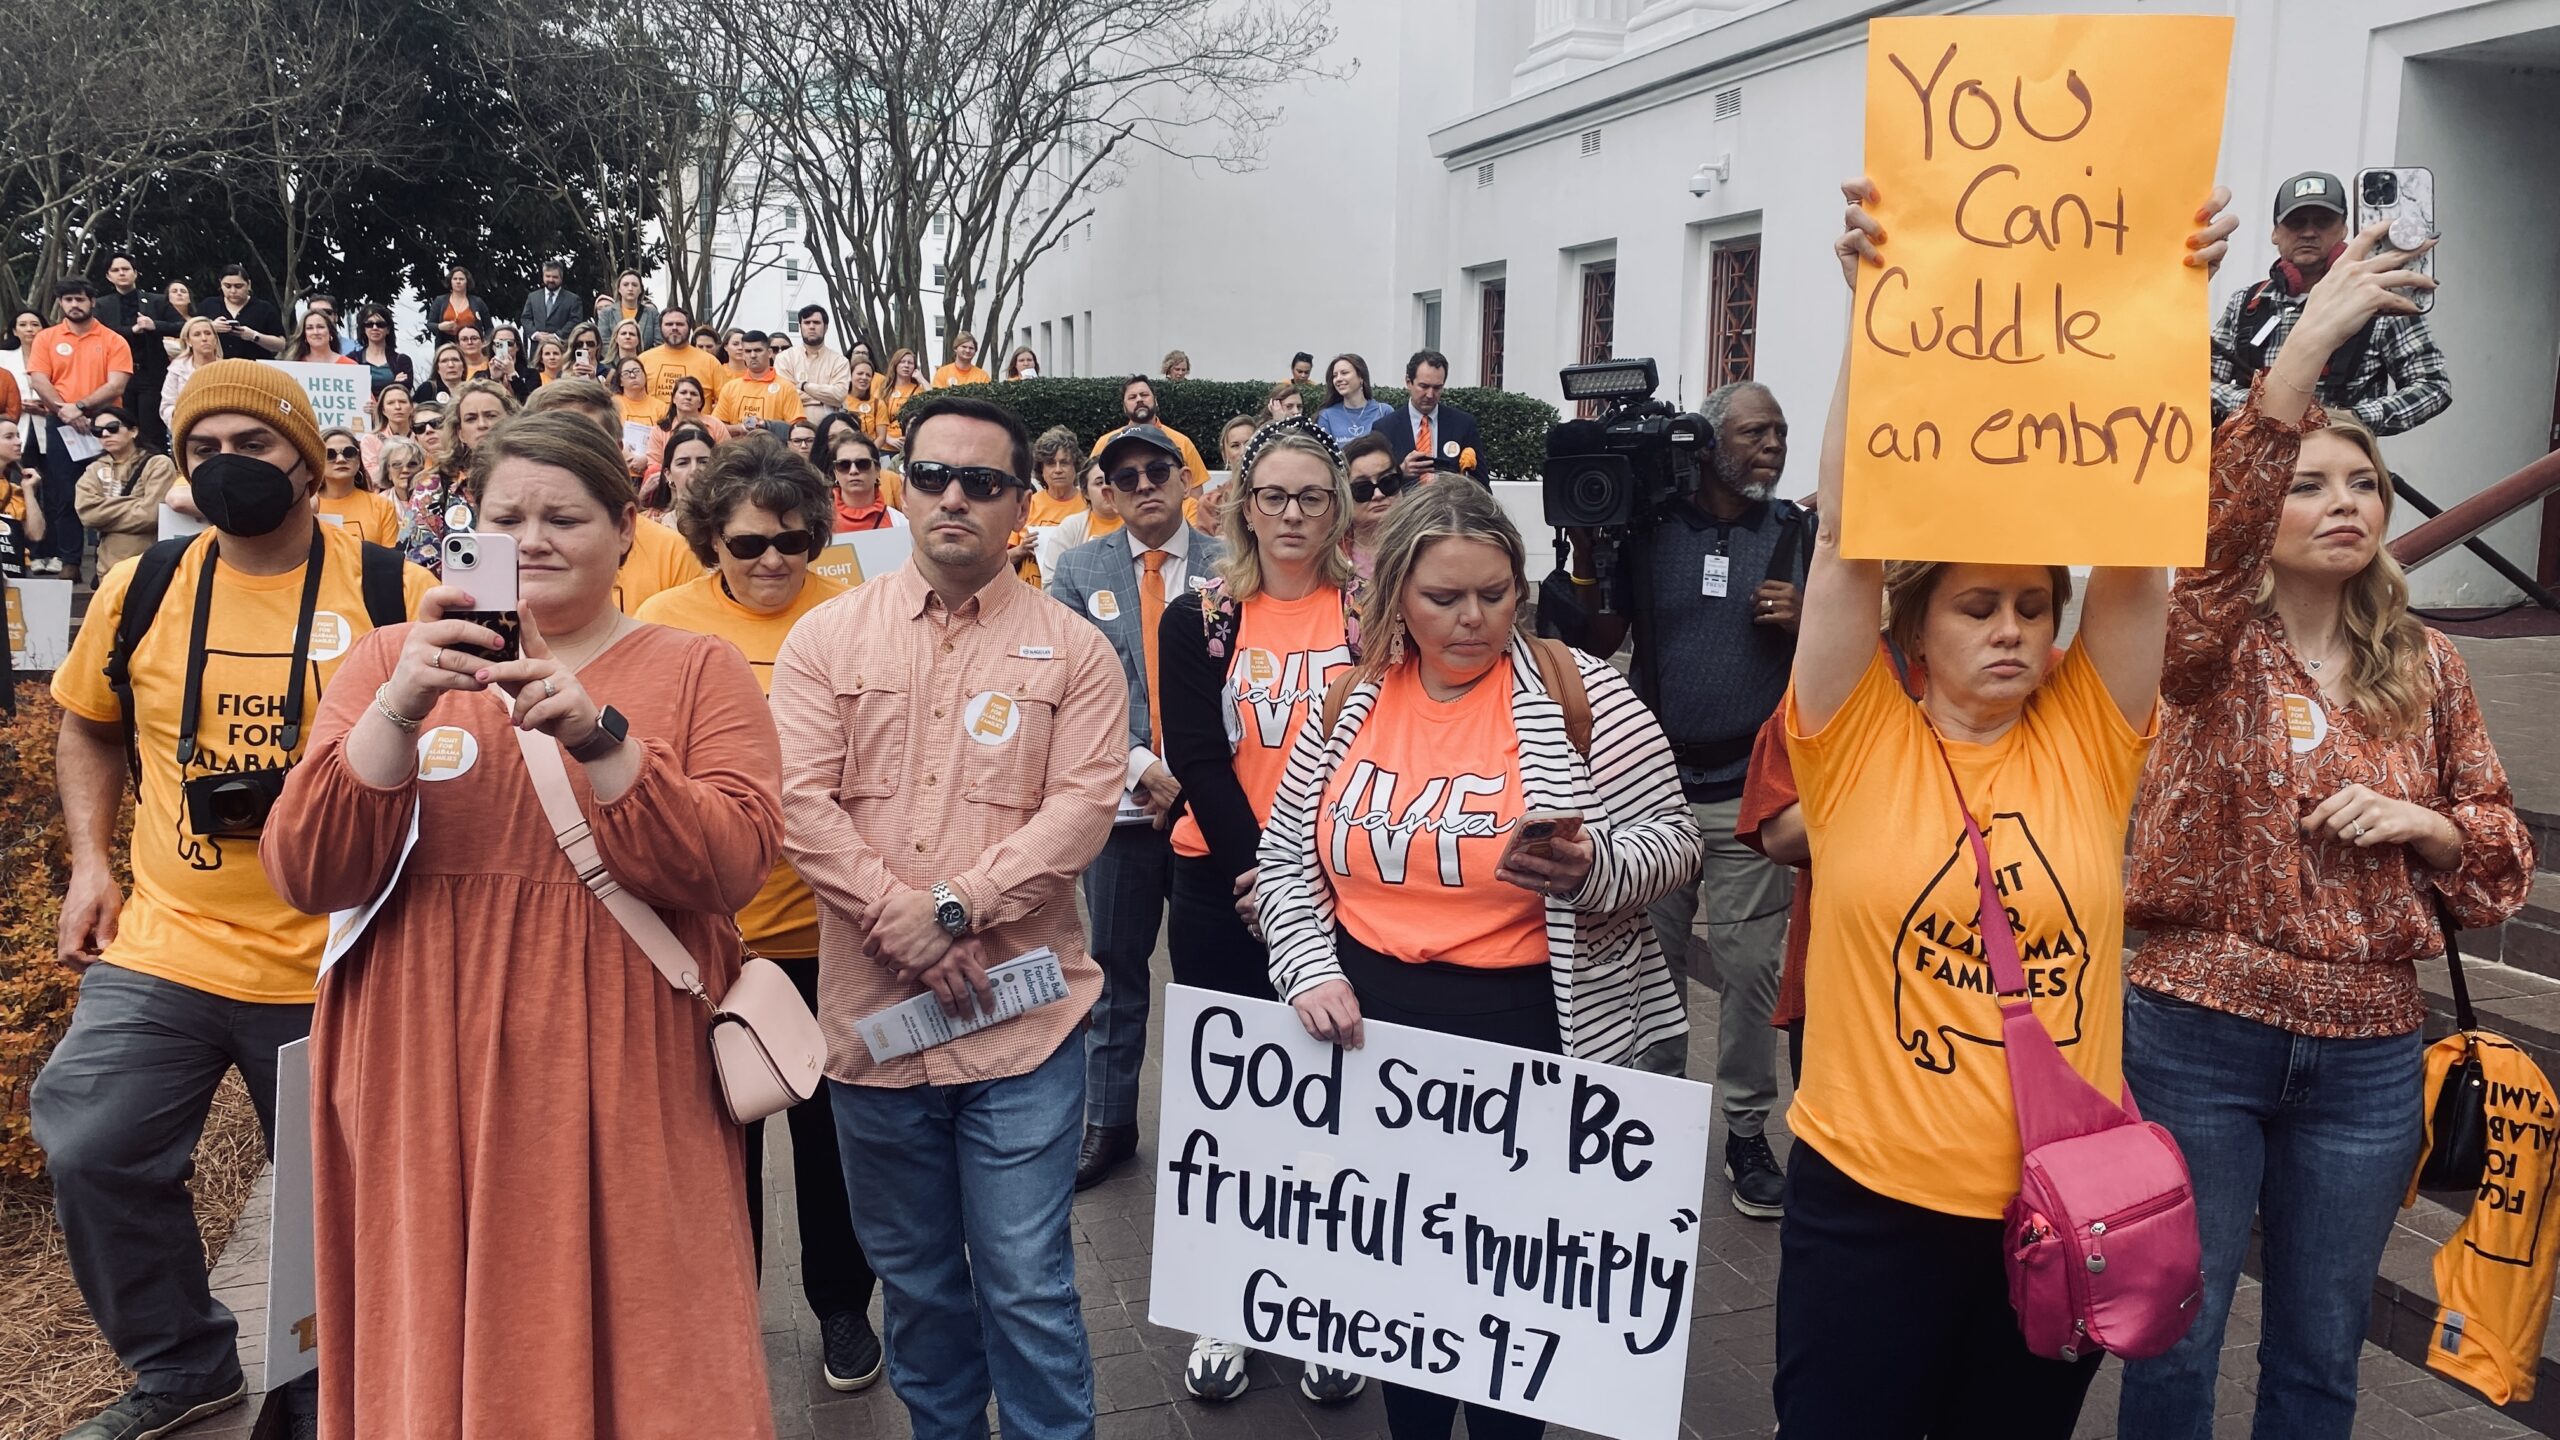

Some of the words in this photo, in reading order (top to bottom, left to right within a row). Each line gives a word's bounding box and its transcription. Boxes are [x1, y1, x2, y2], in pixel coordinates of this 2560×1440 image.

[1956, 165, 2129, 255] Can't
[1866, 267, 2115, 364] Cuddle
[308, 377, 355, 393] HERE
[311, 396, 357, 411] AUSE
[1867, 422, 1941, 462] an
[1971, 401, 2193, 484] embryo
[816, 562, 853, 577] FIGHT
[217, 693, 286, 717] FIGH
[1324, 800, 1518, 835] mama
[1330, 758, 1508, 887] IVF
[1914, 912, 2077, 962] ALAMA
[1022, 968, 1039, 1005] Alabama
[1033, 965, 1049, 998] Families
[1045, 962, 1058, 982] Help
[1915, 945, 2068, 998] FAMIES
[1191, 1006, 1343, 1136] God
[2489, 1116, 2555, 1150] ALAB
[2487, 1149, 2518, 1178] FO
[1169, 1129, 1410, 1265] fruitful
[1422, 1192, 1457, 1254] &
[1243, 1268, 1465, 1374] Genesis
[1480, 1314, 1560, 1402] 9:7
